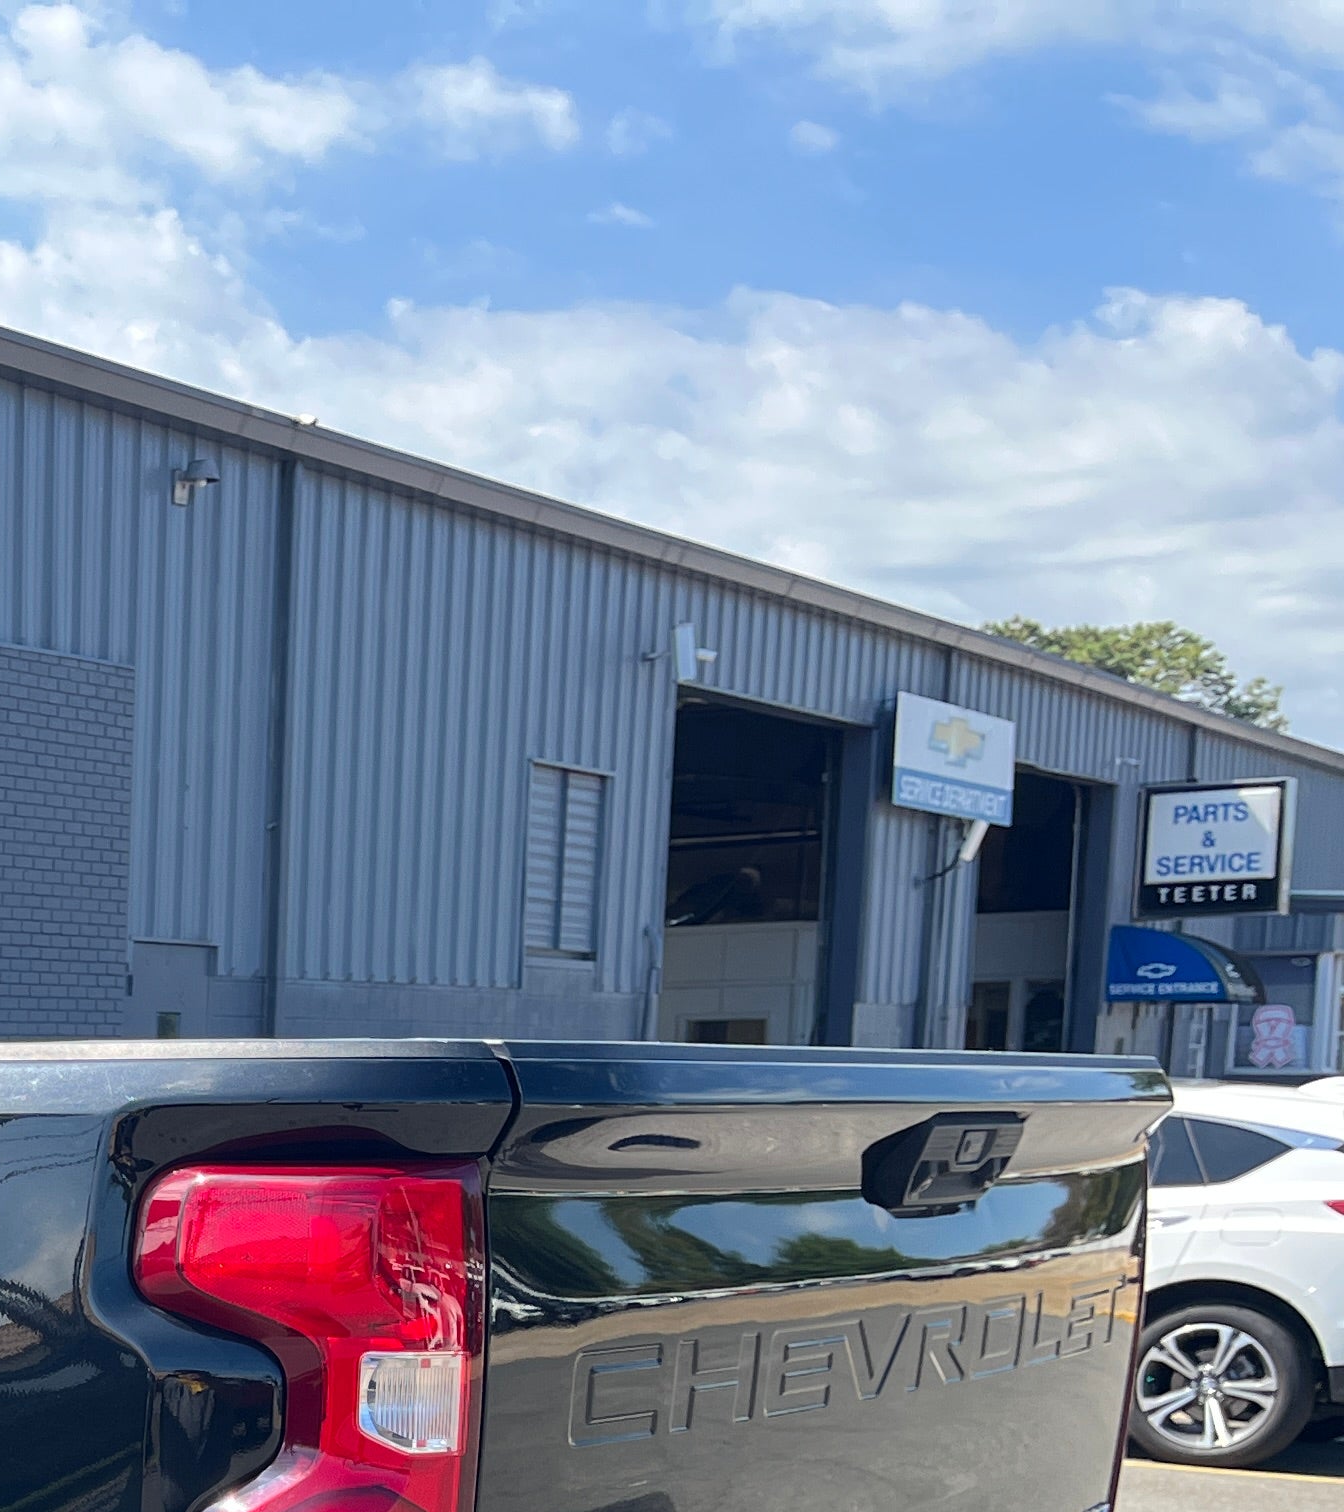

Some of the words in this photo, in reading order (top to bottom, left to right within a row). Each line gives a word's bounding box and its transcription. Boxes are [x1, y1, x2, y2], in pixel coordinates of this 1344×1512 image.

[1173, 801, 1249, 824] PARTS
[1202, 831, 1216, 848] &
[1156, 852, 1261, 876] SERVICE
[1158, 884, 1257, 903] TEETER
[1109, 982, 1155, 996] SERVICE
[1158, 981, 1219, 996] ENTRANCE
[568, 1273, 1127, 1447] CHEVROLET
